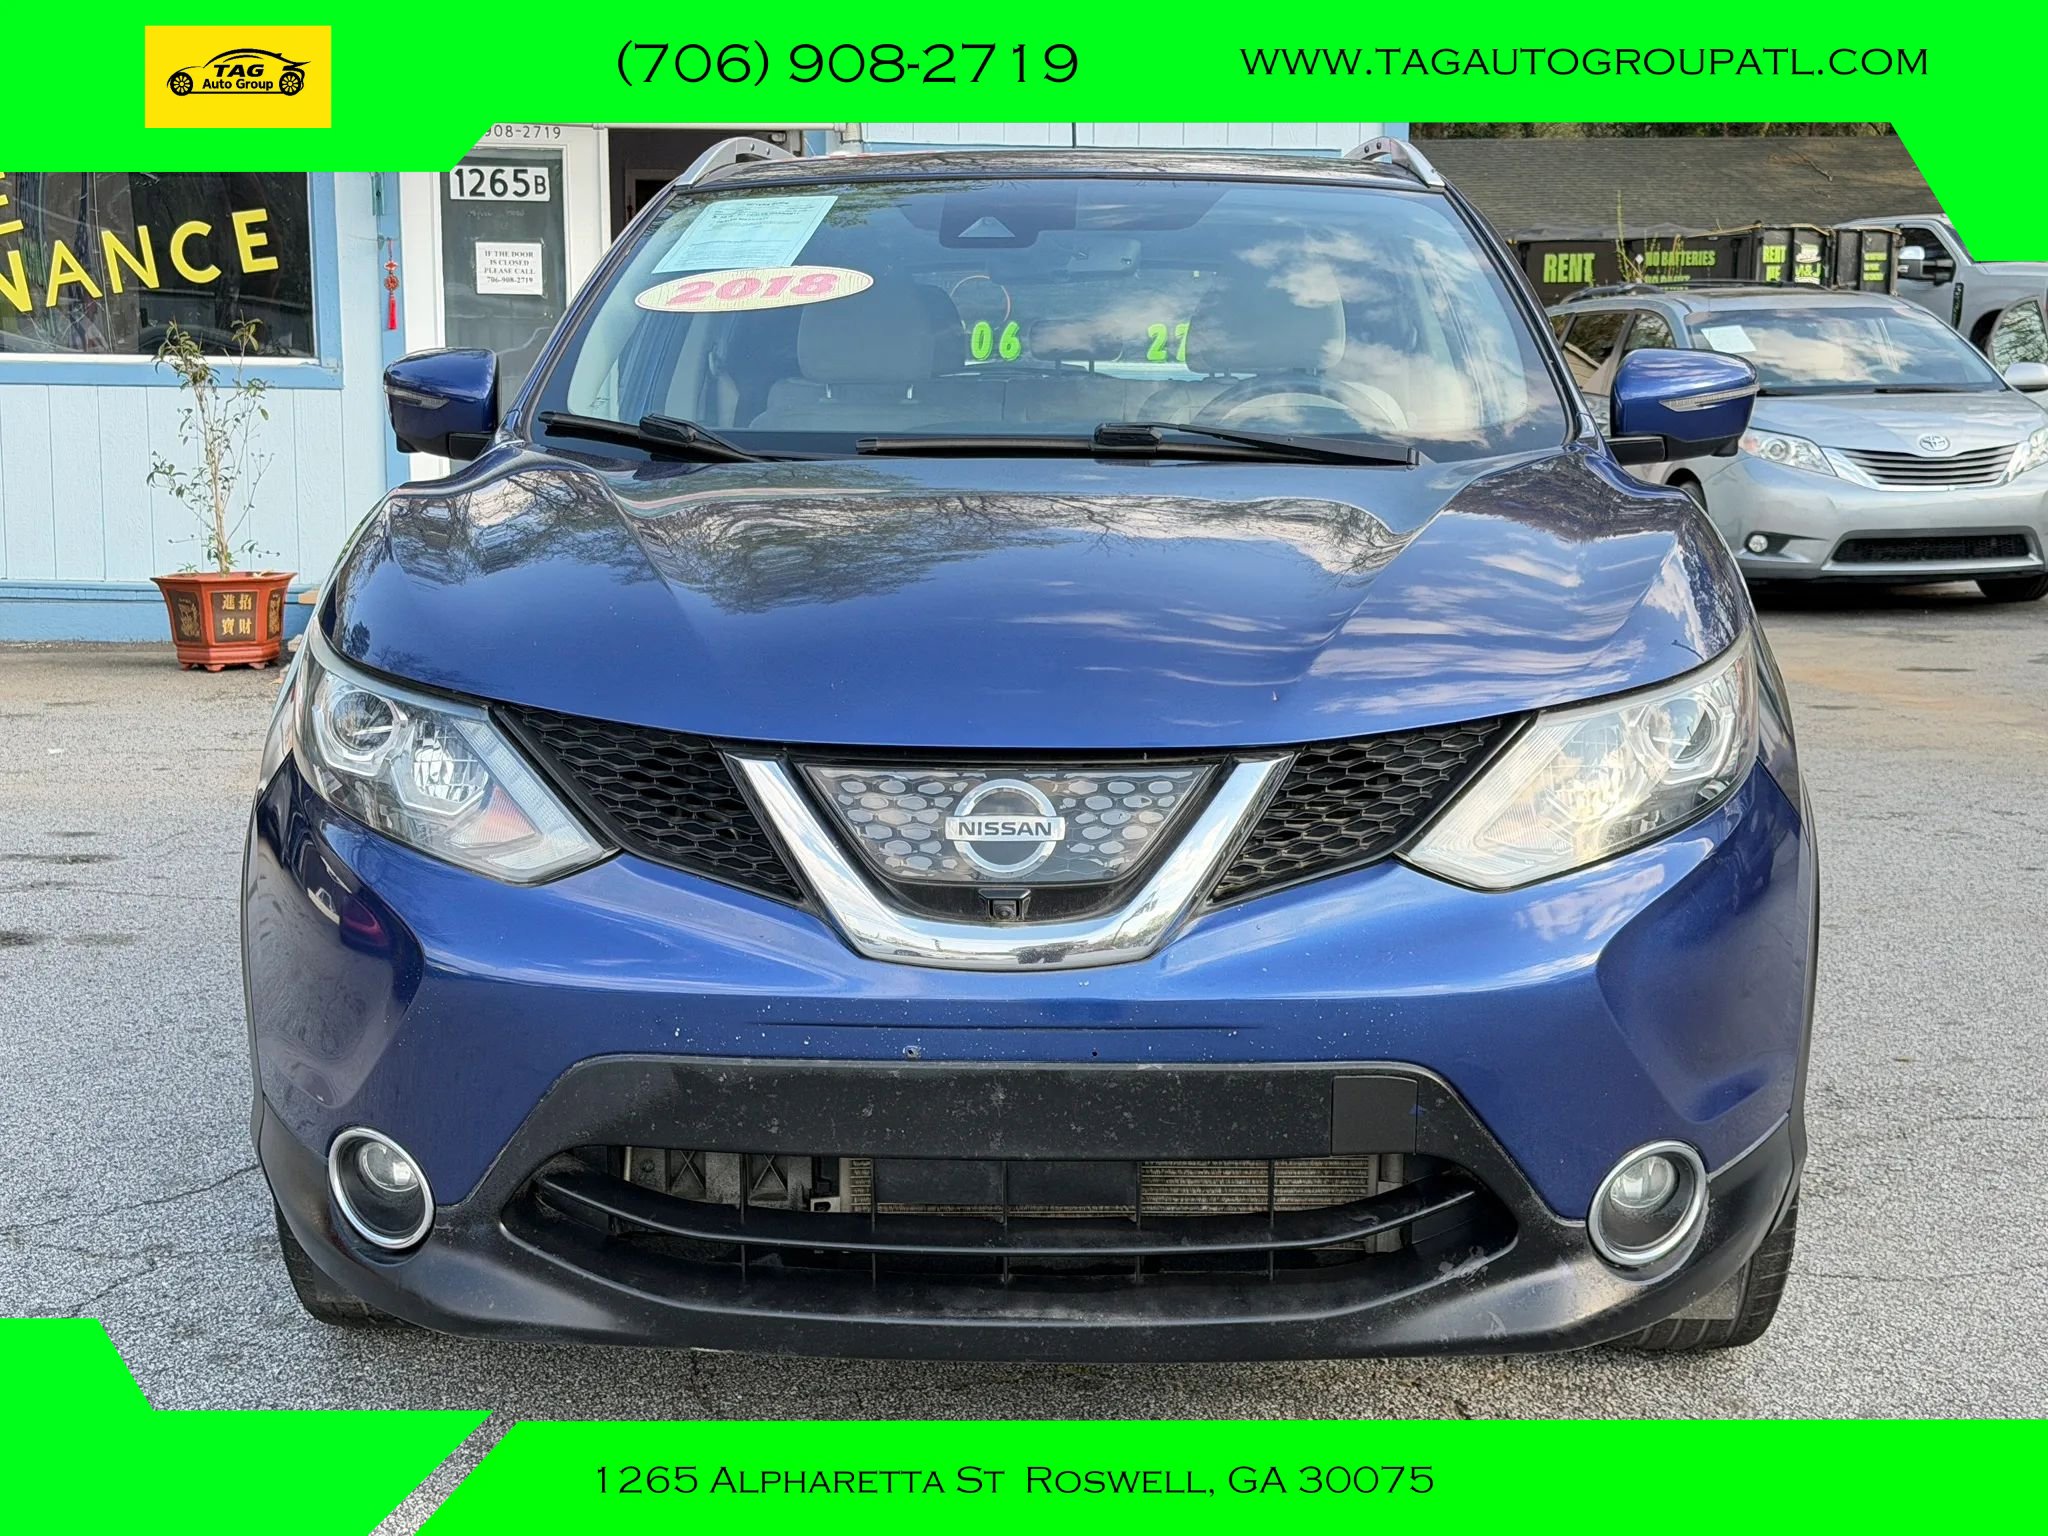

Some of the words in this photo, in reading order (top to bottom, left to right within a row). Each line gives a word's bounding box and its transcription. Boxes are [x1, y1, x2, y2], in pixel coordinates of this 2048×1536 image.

[1645, 251, 1660, 266] NO
[1661, 250, 1716, 266] BATTERIES
[1762, 245, 1787, 263] RENT
[1543, 252, 1596, 284] RENT
[486, 276, 534, 284] 706-908-2719
[665, 273, 839, 307] 2018
[970, 321, 1022, 362] 06
[958, 821, 1052, 837] NISSAN
